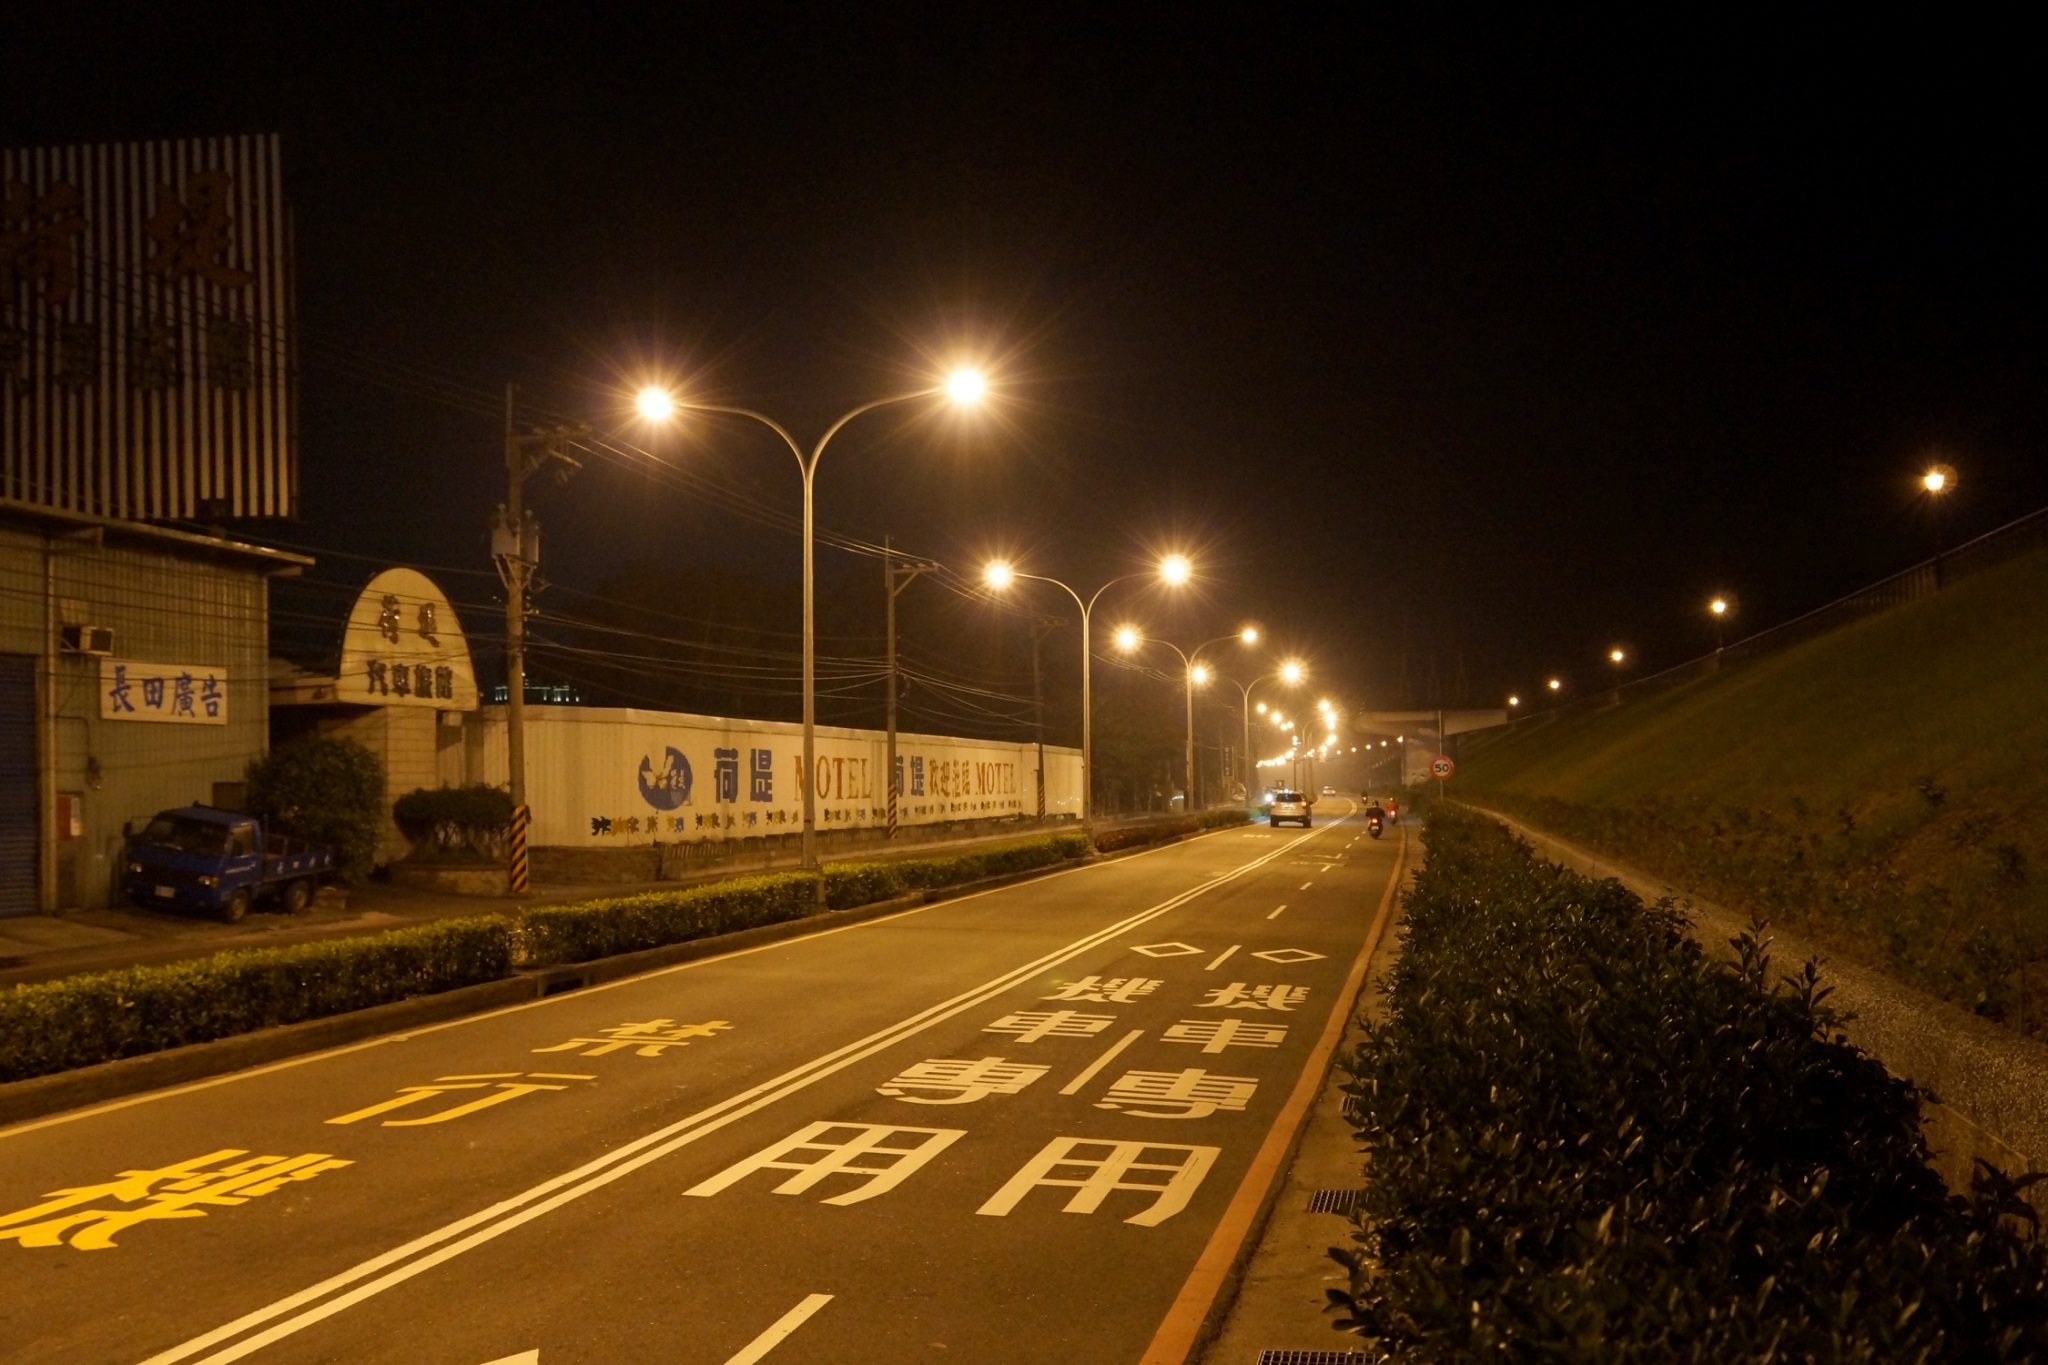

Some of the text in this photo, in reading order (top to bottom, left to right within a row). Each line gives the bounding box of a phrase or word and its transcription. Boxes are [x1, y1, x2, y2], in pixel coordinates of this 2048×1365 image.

[109, 665, 222, 718] 長田廣告
[975, 762, 1017, 796] MOTEL
[1435, 764, 1449, 772] 50
[682, 976, 1163, 1207] 機車專用
[981, 983, 1310, 1226] 機車專用
